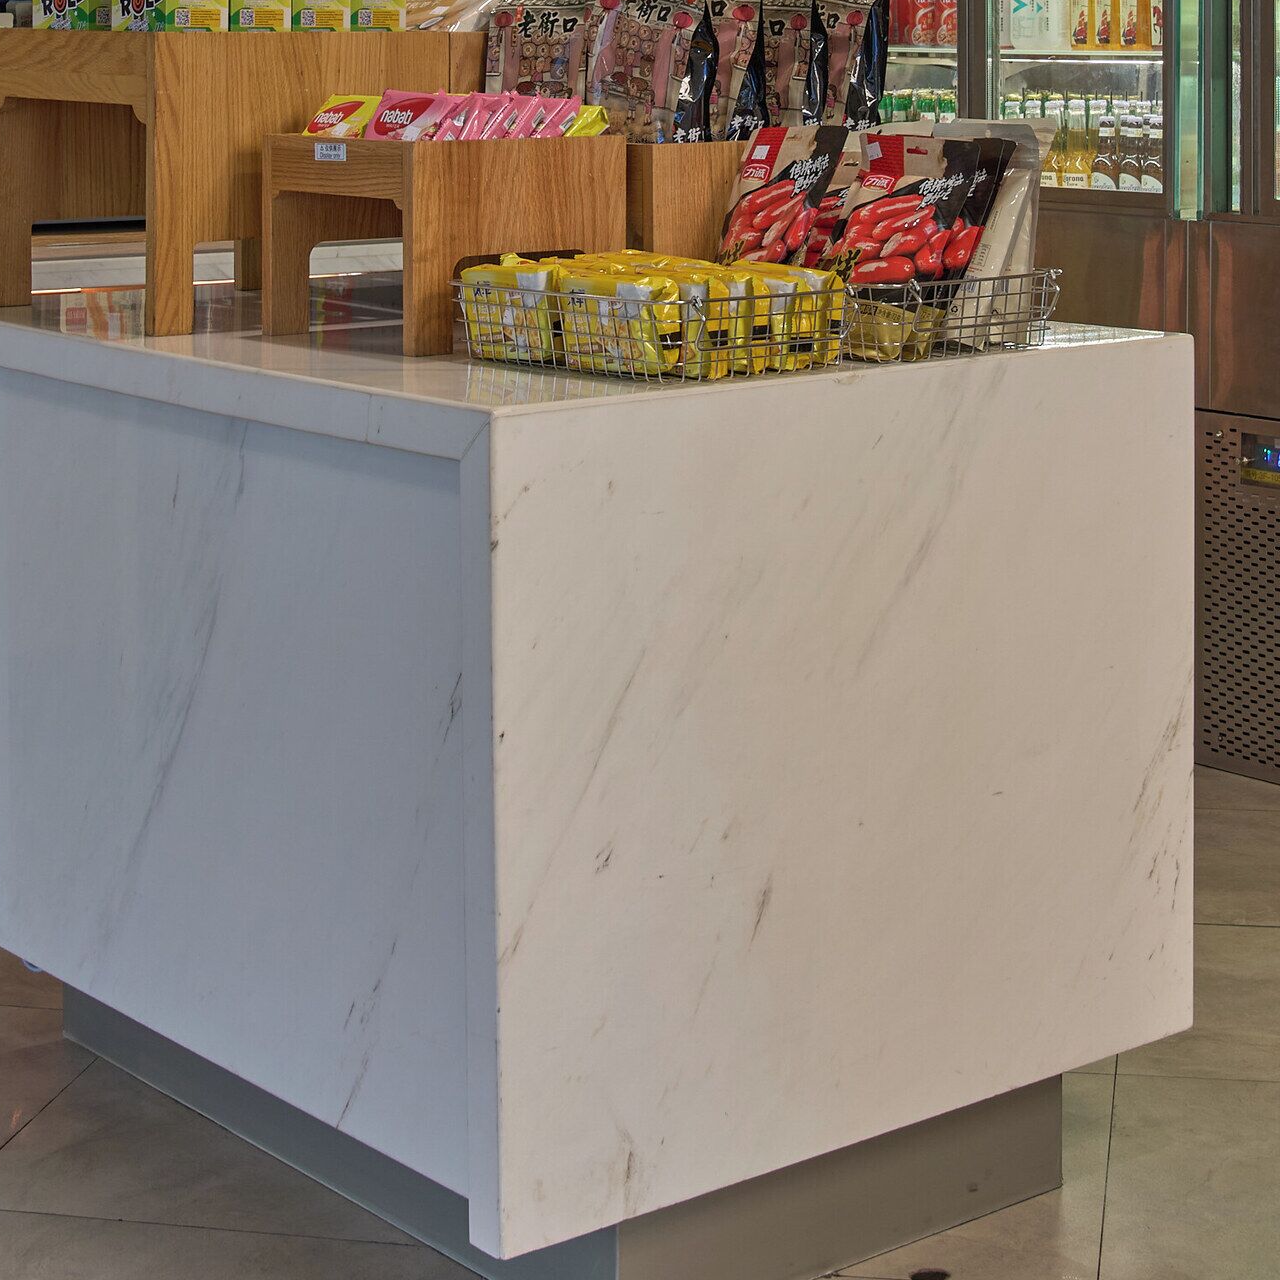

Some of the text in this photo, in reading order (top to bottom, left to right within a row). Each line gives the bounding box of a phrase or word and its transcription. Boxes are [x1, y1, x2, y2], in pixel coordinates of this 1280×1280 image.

[518, 11, 578, 38] 老街口
[315, 110, 344, 124] nabati
[381, 108, 413, 125] nabati
[743, 166, 767, 180] 力诚
[864, 176, 892, 190] 力诚
